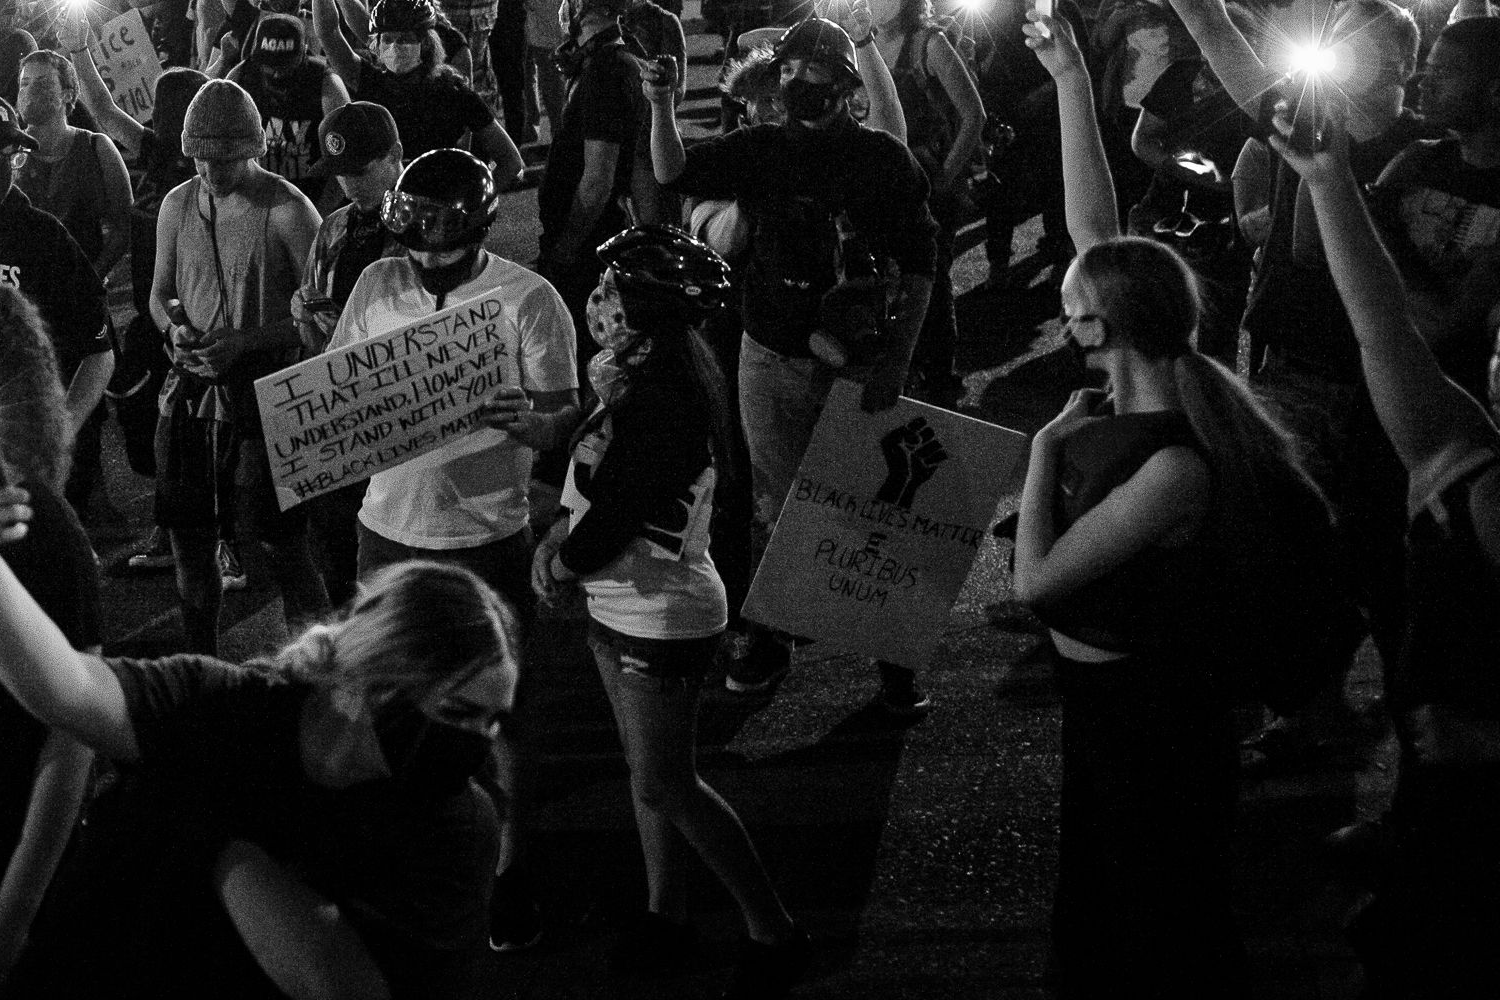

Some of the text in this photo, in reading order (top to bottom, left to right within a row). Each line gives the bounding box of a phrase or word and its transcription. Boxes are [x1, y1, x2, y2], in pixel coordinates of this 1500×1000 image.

[274, 299, 501, 408] I UNDERSTAND
[286, 381, 359, 426] THAT
[426, 324, 500, 370] NEVER
[411, 343, 509, 404] HOWEVER
[280, 366, 503, 480] I STAND WITH YOU
[795, 478, 984, 550] BLACK LIVES MATTER
[864, 531, 888, 556] E
[814, 538, 919, 590] PLURIBUS
[828, 573, 889, 608] UNUM
